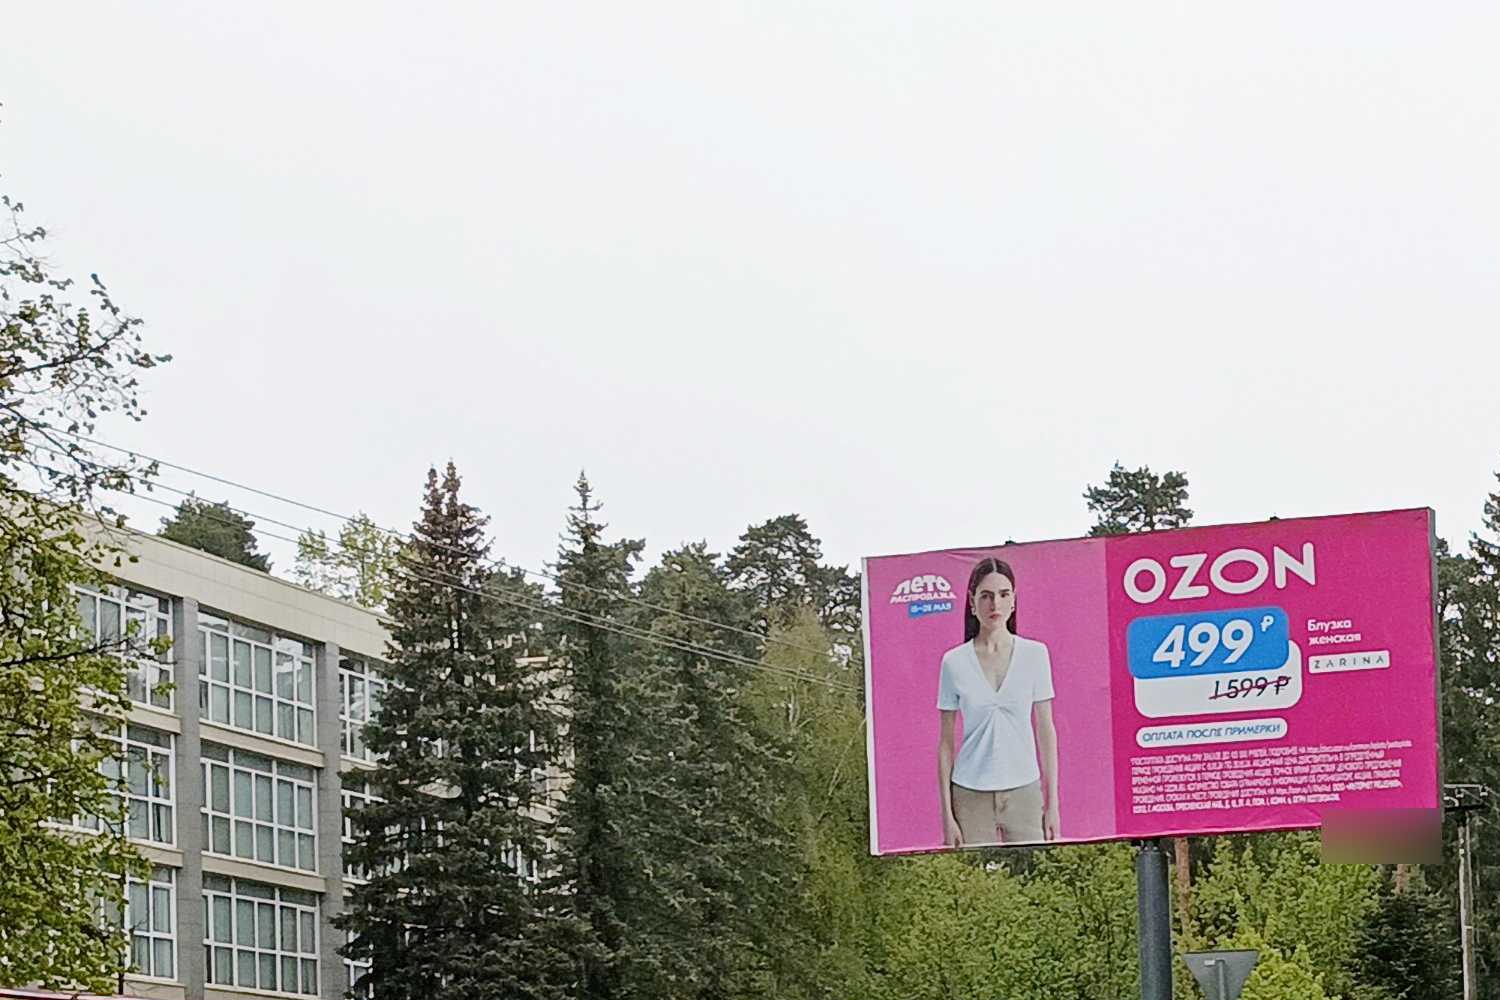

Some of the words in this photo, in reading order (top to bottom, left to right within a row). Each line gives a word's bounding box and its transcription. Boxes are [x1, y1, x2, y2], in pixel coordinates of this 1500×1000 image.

[1123, 542, 1316, 604] OZON
[1307, 619, 1352, 633] Блузка
[1152, 619, 1254, 668] 499
[1308, 633, 1361, 646] женская
[1314, 655, 1384, 669] ZARINA
[1142, 731, 1184, 742] ОПЛАТА
[1186, 727, 1222, 739] ПОСЛЕ
[1225, 724, 1281, 736] ПРИМЕРКИ
